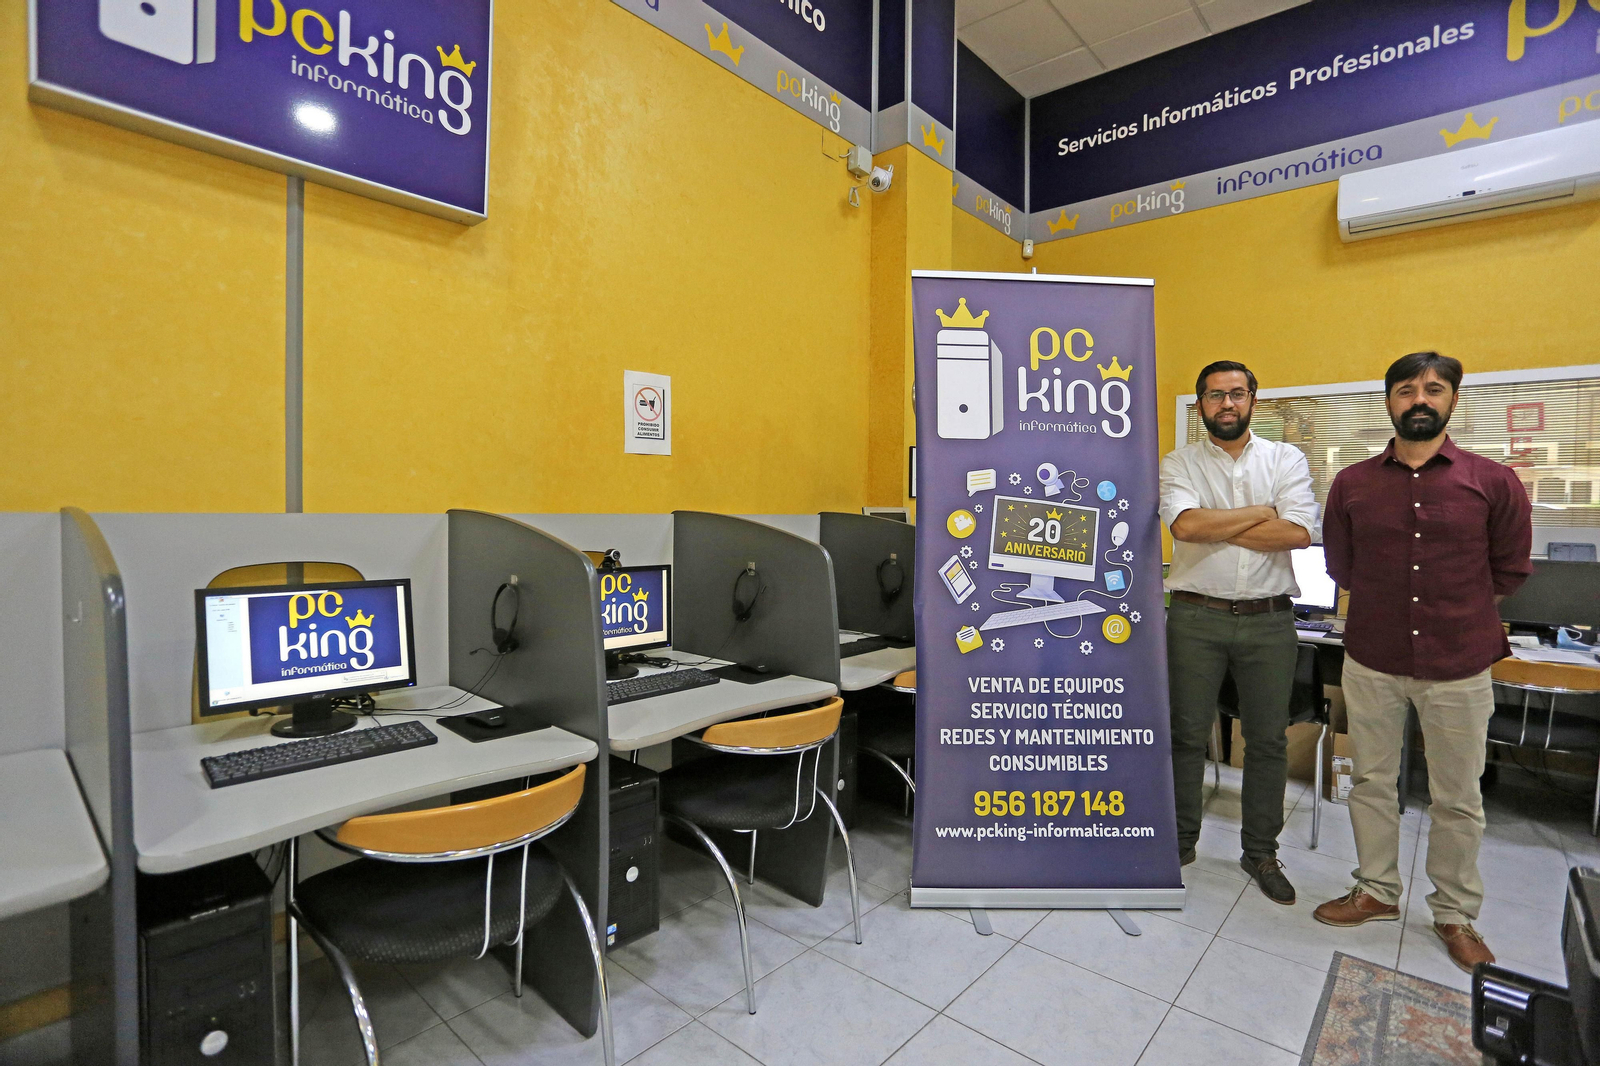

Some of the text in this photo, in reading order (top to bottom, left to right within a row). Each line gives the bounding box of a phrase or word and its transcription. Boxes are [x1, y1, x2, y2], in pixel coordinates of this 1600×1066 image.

[291, 54, 434, 125] informática
[777, 70, 841, 133] pcking
[1057, 22, 1475, 156] Servicios Informáticos Profesionales
[1110, 144, 1383, 223] pcking informática
[976, 195, 1011, 235] pcking
[1029, 326, 1094, 371] pc
[1017, 366, 1132, 438] king
[1019, 419, 1097, 434] informática
[1027, 517, 1061, 544] 20
[1004, 541, 1086, 563] ANIVERSARIO
[600, 573, 632, 602] pc
[288, 591, 344, 629] pc
[278, 623, 375, 670] king
[281, 661, 348, 677] informática
[968, 677, 1124, 696] VENTA DE EQUIPOS
[970, 699, 1123, 719] SERVICIO TÉCNICO
[940, 728, 1154, 745] REDES Y MANTENIMIENTO
[989, 755, 1108, 771] CONSUMIBLES
[974, 790, 1125, 816] 956 187 148
[935, 823, 1155, 841] www.pcking-informatica.com
